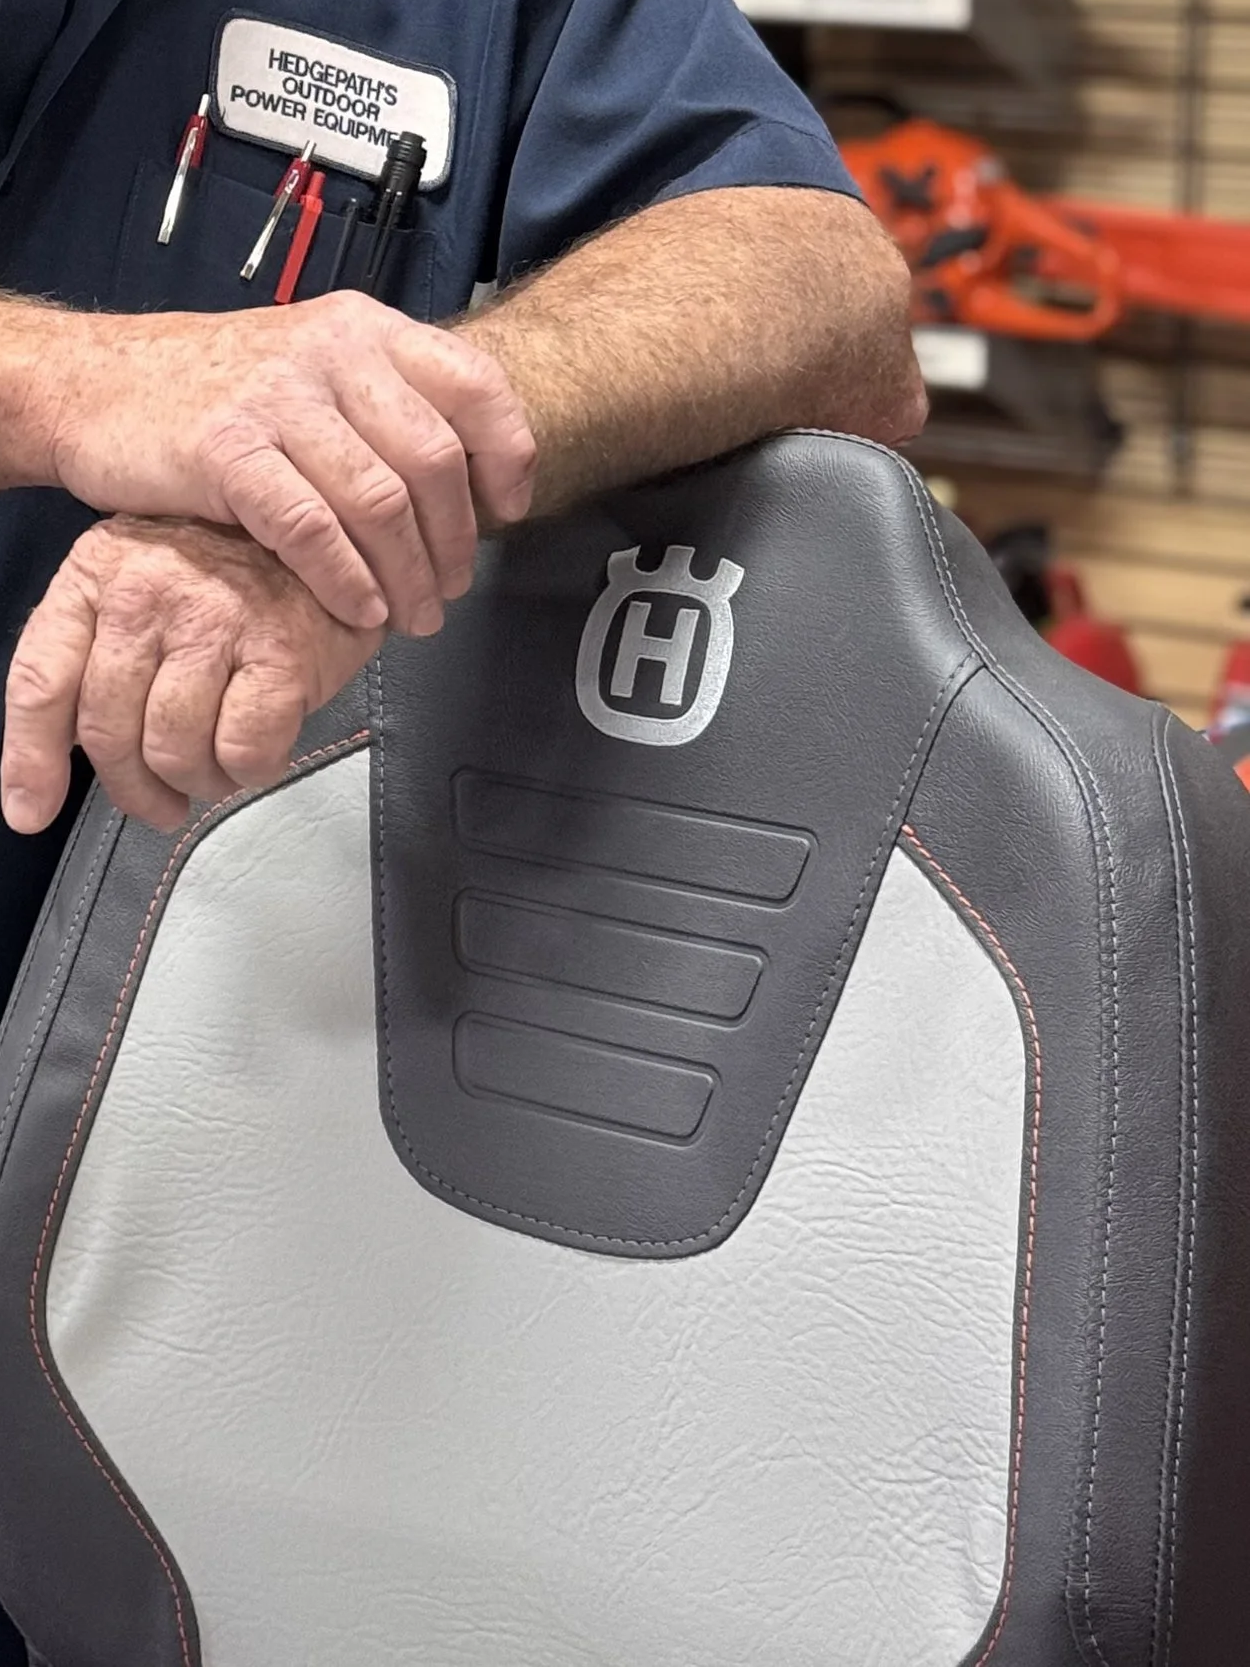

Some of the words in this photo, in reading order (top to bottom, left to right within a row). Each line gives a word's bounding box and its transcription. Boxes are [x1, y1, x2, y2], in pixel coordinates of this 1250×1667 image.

[268, 48, 399, 106] HEDGEPATH'S
[282, 77, 381, 122] OUTDOOR
[230, 85, 307, 121] POWER
[313, 108, 400, 147] EQUIPME
